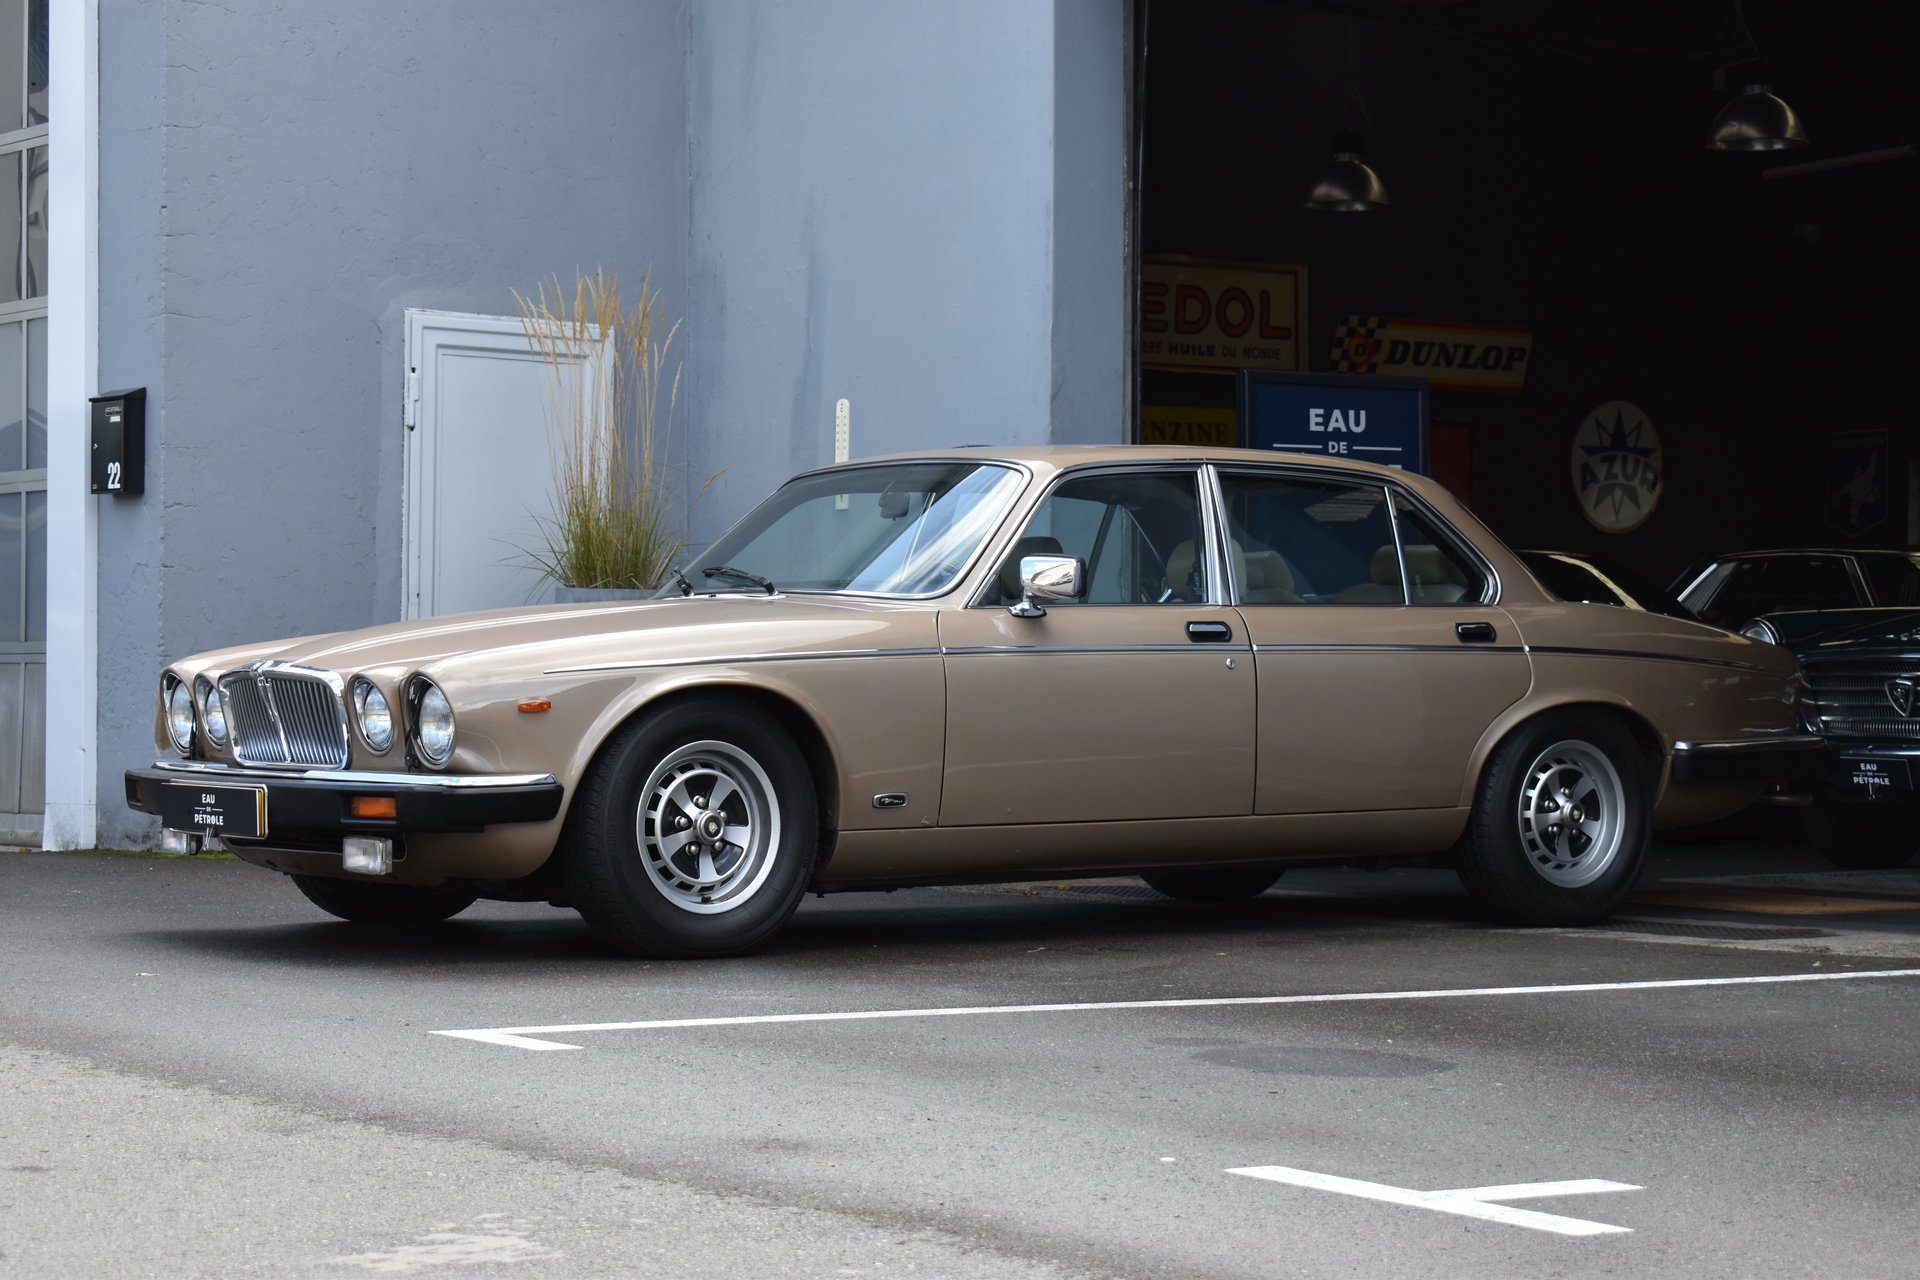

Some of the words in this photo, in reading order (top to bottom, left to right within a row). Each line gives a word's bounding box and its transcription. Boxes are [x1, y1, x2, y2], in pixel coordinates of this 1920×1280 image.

[1168, 343, 1216, 357] HUILE
[1222, 345, 1237, 358] DU
[1243, 347, 1281, 360] MONDE
[1354, 343, 1367, 356] D
[1383, 340, 1527, 371] DUNLOP
[1308, 408, 1367, 433] EAU
[1328, 441, 1348, 454] DE
[107, 462, 121, 489] 22
[1580, 455, 1658, 493] AZUR
[1860, 763, 1877, 771] EAU
[201, 793, 216, 804] EAU
[194, 810, 224, 826] PÉTROLE
